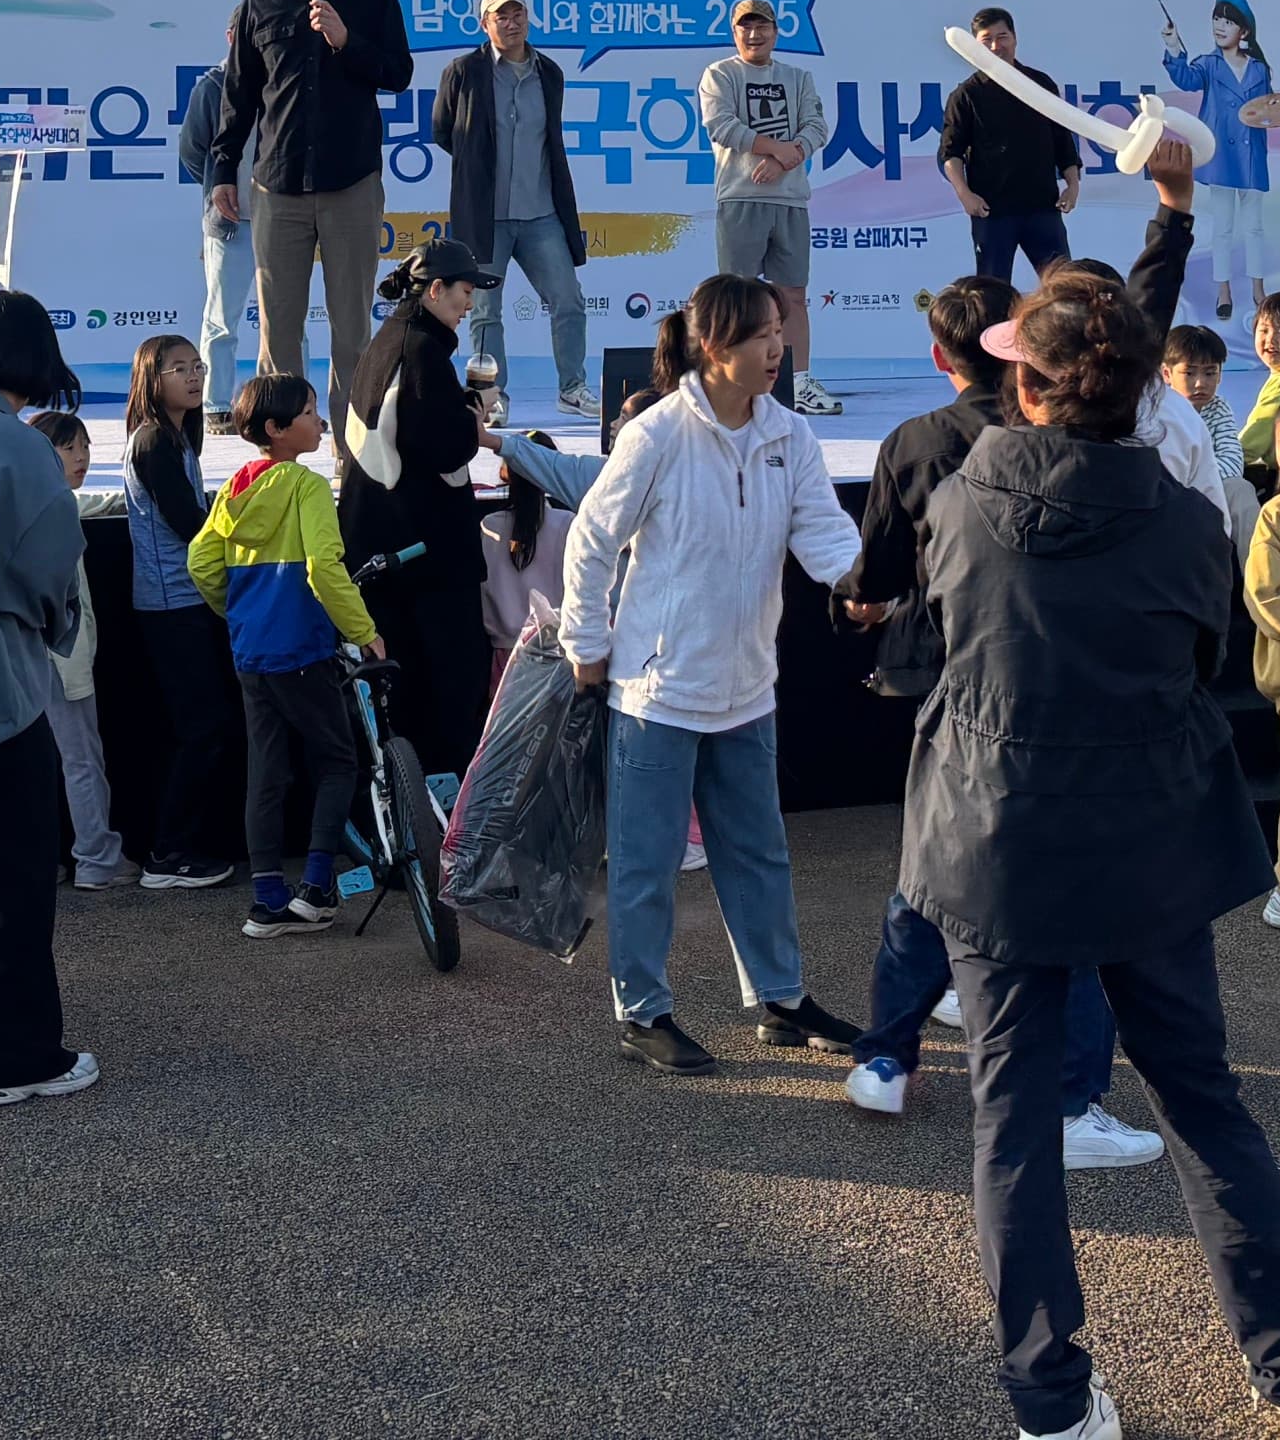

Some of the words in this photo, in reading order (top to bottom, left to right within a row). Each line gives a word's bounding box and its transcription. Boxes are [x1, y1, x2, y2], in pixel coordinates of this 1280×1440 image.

[590, 2, 696, 35] 함께하는
[853, 227, 928, 249] 삼패지구
[841, 292, 900, 306] 경기도교육청
[113, 310, 178, 327] 경인일보
